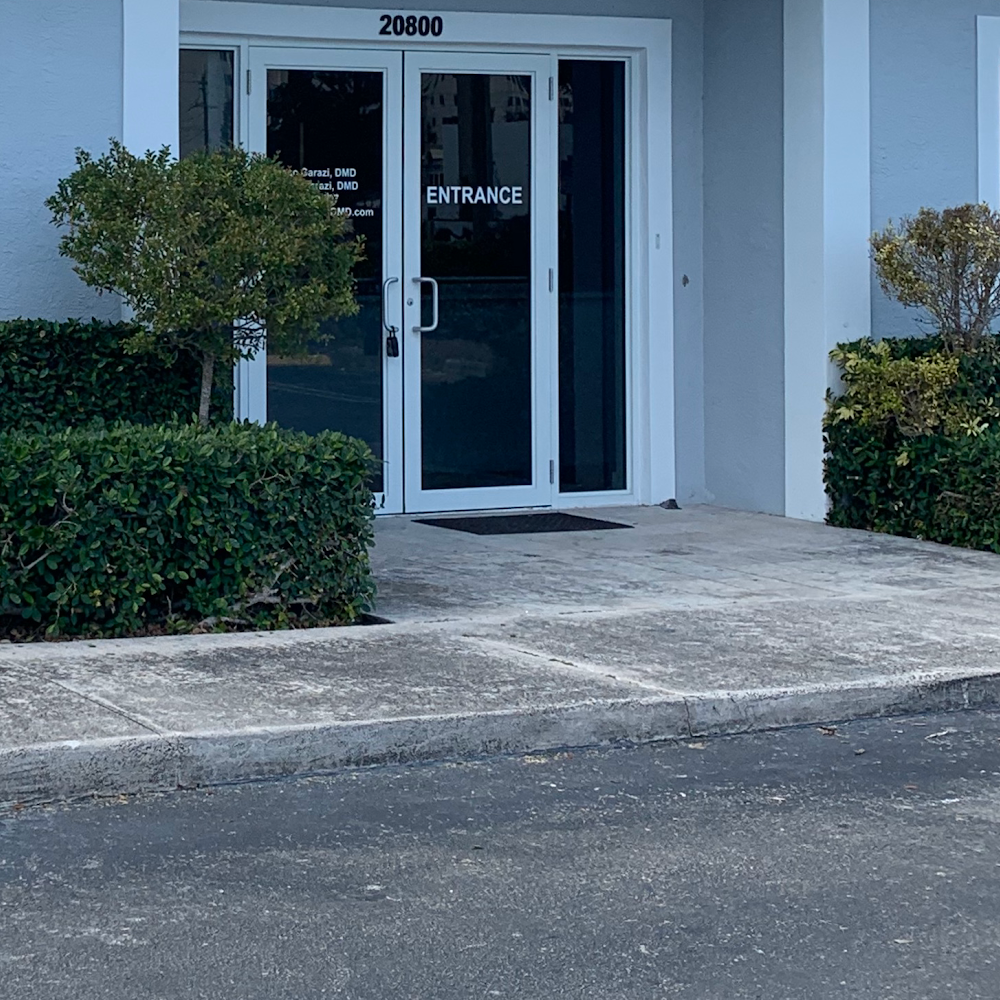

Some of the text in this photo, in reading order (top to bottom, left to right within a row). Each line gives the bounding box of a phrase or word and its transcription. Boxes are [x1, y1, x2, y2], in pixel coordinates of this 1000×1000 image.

[379, 14, 443, 36] 20800
[335, 168, 357, 178] DMD
[337, 181, 359, 190] DMD
[426, 186, 523, 204] ENTRANCE
